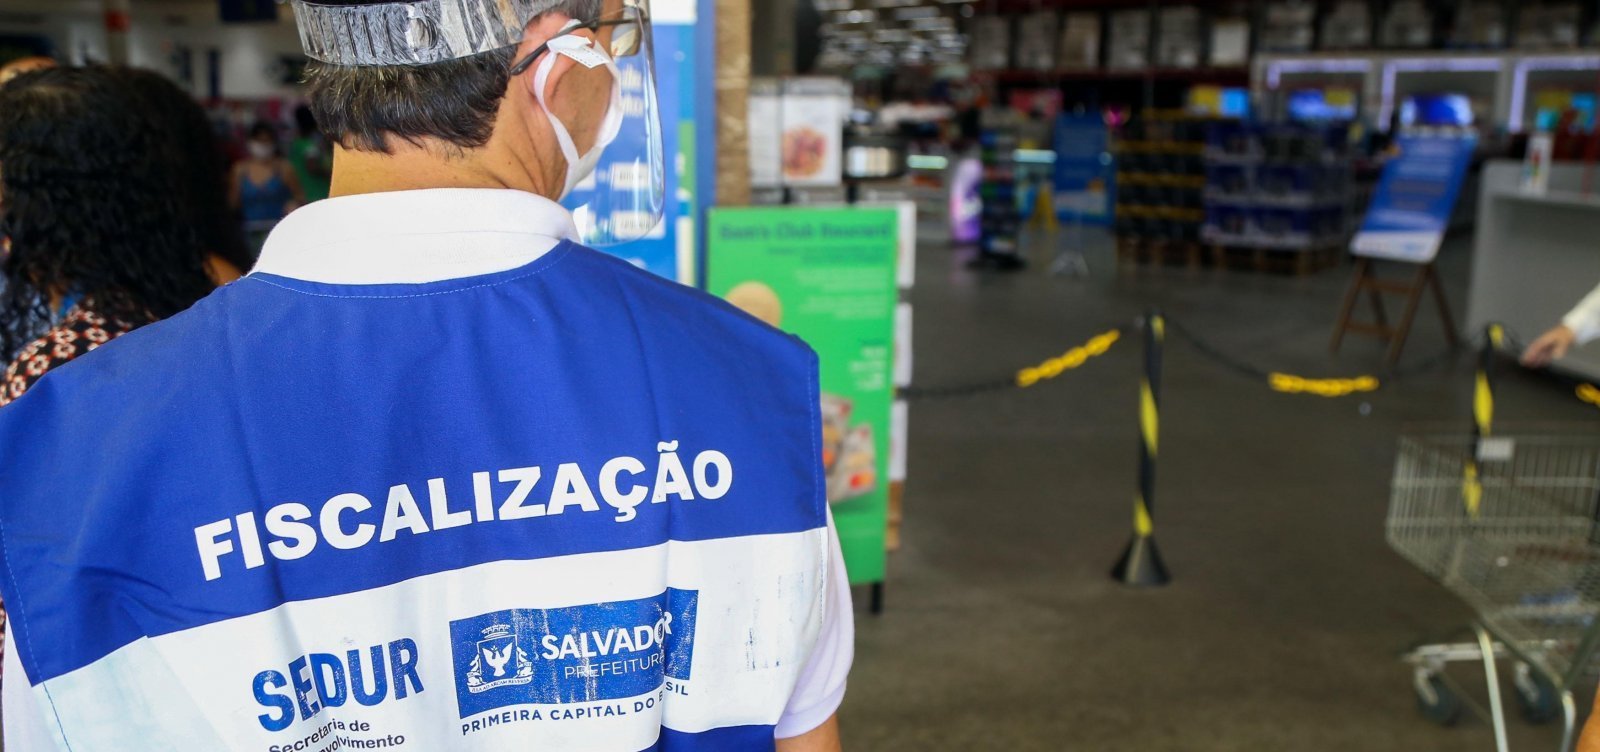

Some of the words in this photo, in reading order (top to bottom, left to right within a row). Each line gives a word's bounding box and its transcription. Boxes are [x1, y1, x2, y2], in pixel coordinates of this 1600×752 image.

[194, 440, 733, 581] FISCALIZAÇÃO
[541, 611, 673, 661] SALVADOR
[252, 637, 425, 732] SEDUR
[269, 718, 345, 752] Secretaria
[350, 720, 370, 732] de
[462, 708, 543, 735] PRIMEIRA
[550, 703, 626, 720] CAPITAL
[634, 697, 655, 713] DO
